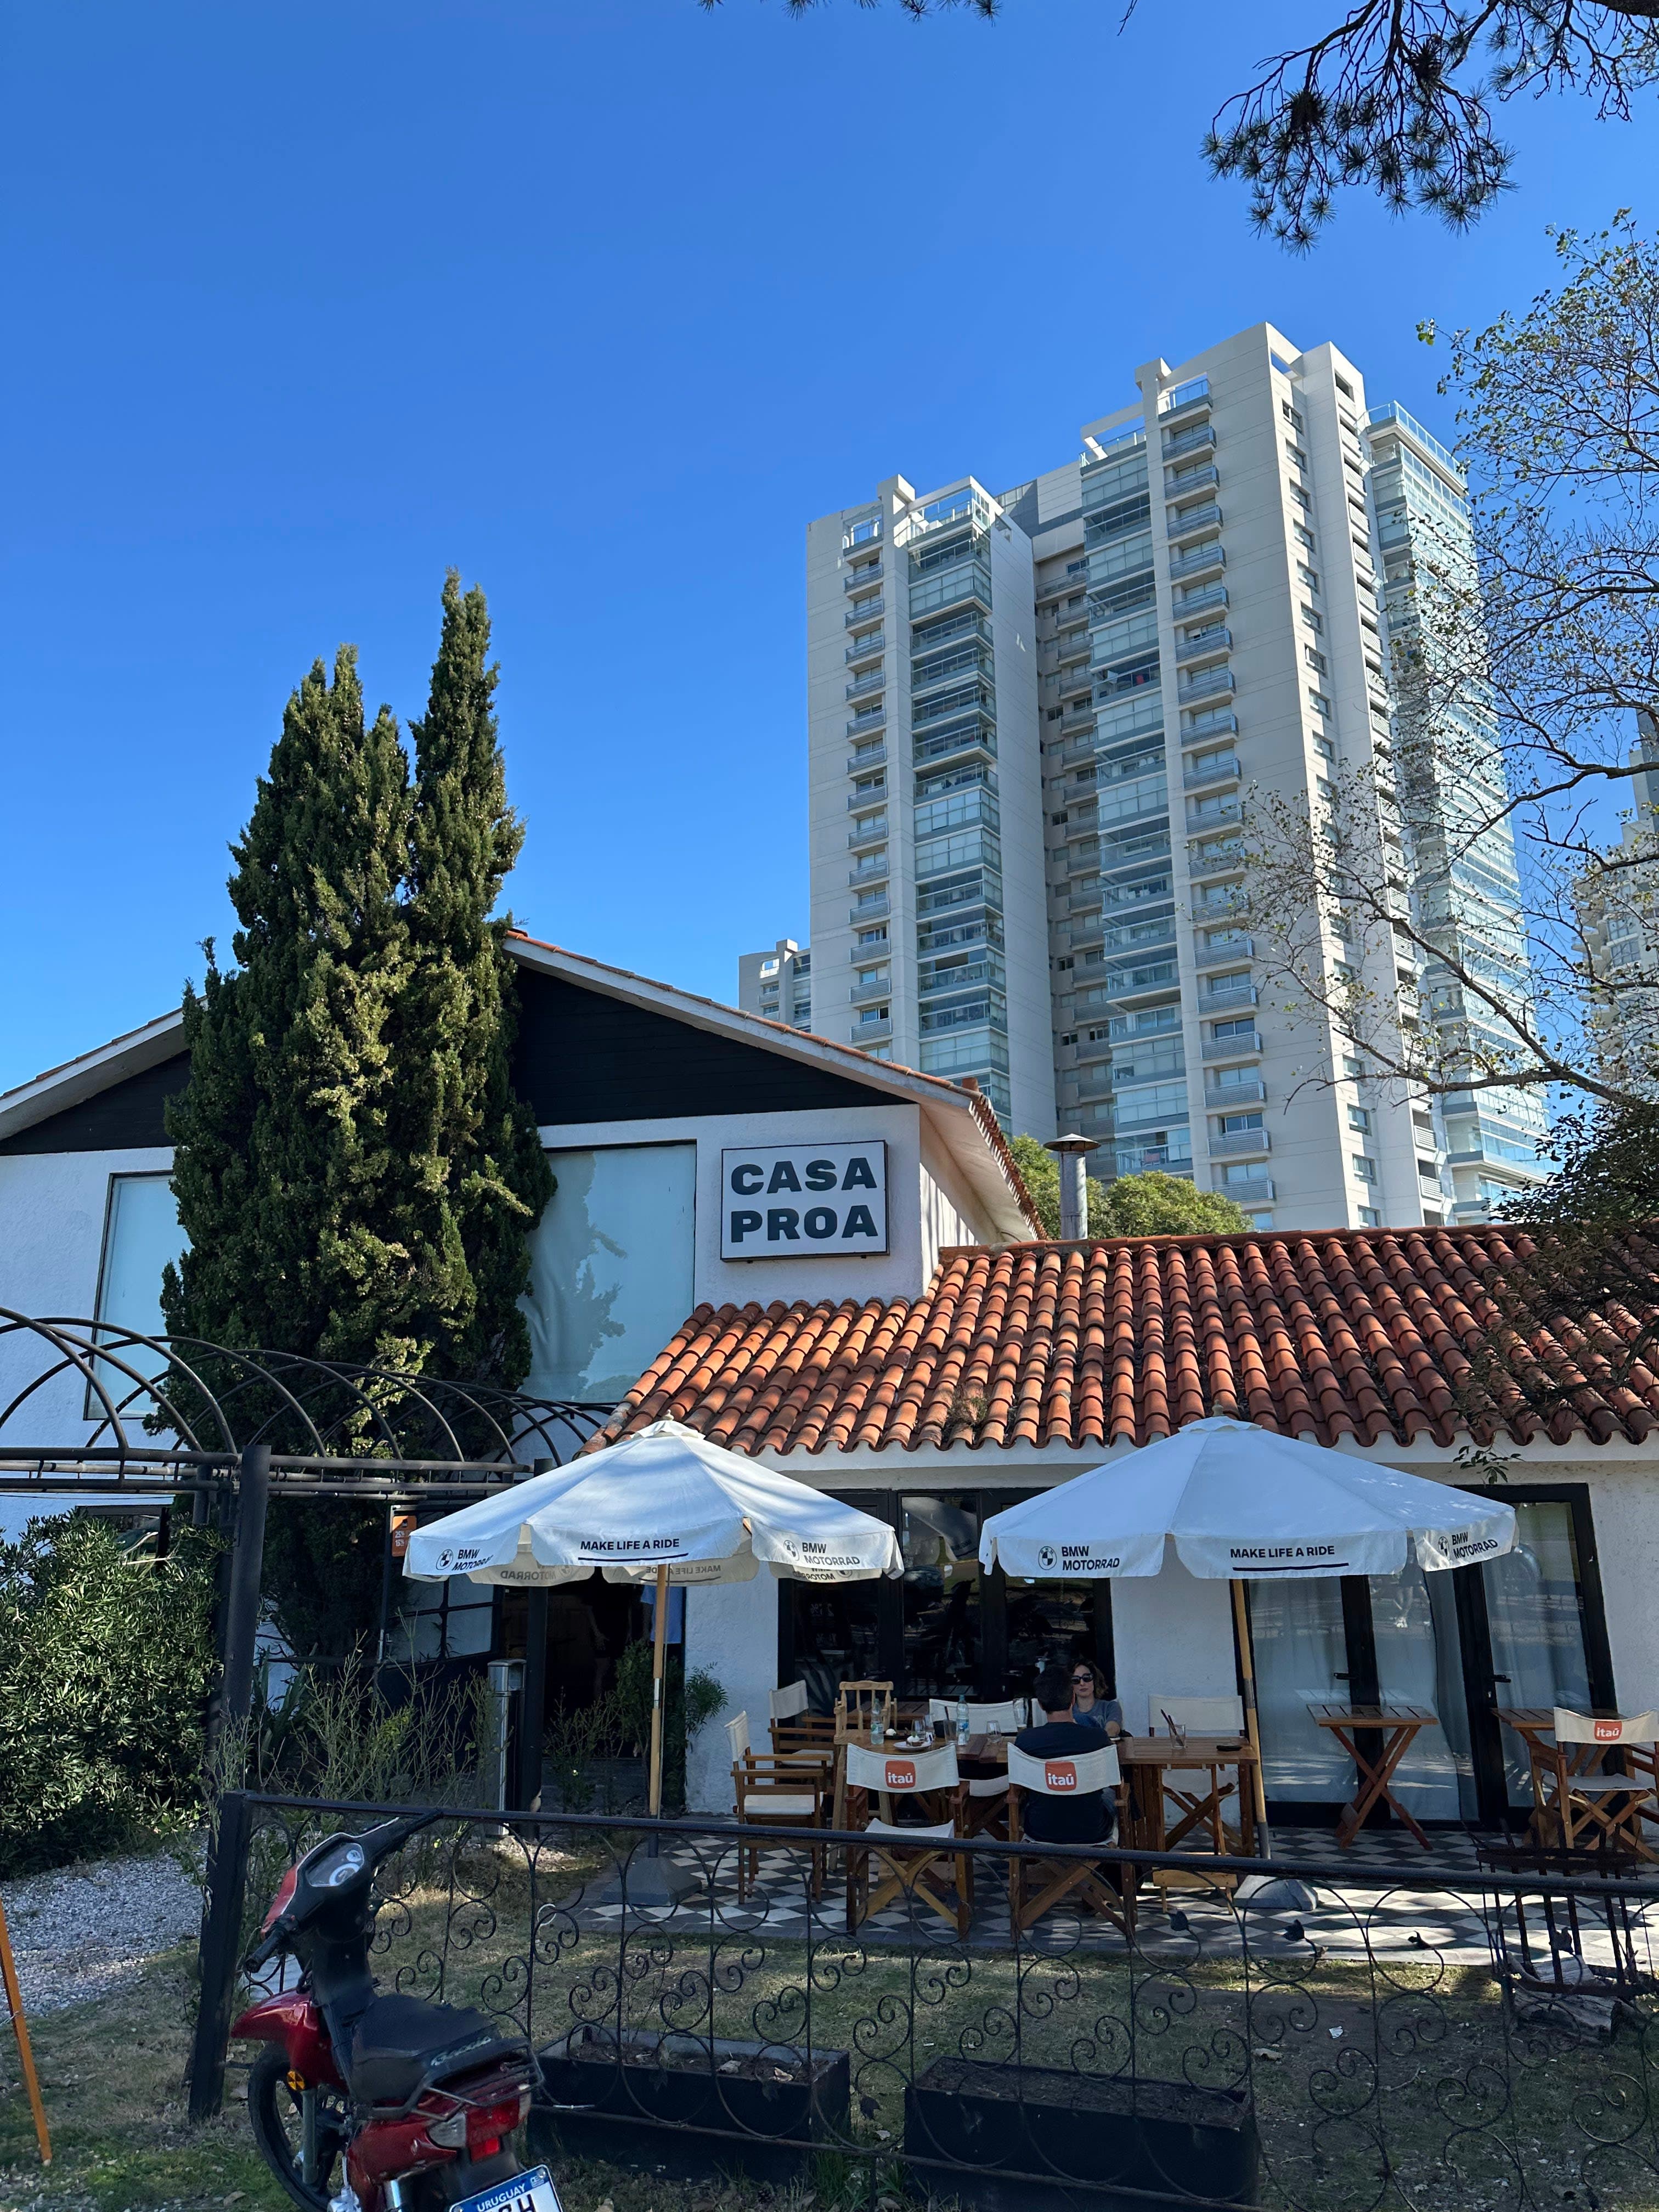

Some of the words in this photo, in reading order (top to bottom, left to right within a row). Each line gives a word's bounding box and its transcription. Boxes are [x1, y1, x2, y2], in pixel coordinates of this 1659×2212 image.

[731, 1158, 877, 1195] CASA
[731, 1205, 878, 1243] PROA
[580, 1541, 614, 1550] MAKE
[617, 1541, 640, 1550] LIFE
[642, 1540, 651, 1549] A
[653, 1538, 680, 1549] RIDE
[1452, 1532, 1468, 1545] BMW
[458, 1549, 480, 1559] BMW
[802, 1542, 827, 1554] BMW
[1062, 1545, 1090, 1556] BMW
[1231, 1549, 1266, 1558] MAKE
[1268, 1548, 1293, 1558] LIFE
[1295, 1548, 1304, 1557] A
[1306, 1545, 1335, 1556] RIDE
[1453, 1539, 1498, 1559] MOTORRAD
[804, 1555, 860, 1565] MOTORRAD
[1063, 1558, 1120, 1571] MOTORRAD
[1596, 1727, 1620, 1738] itaú
[888, 1772, 913, 1784] itaú
[1048, 1773, 1074, 1786] itaú
[477, 2183, 526, 2211] URUGUAY
